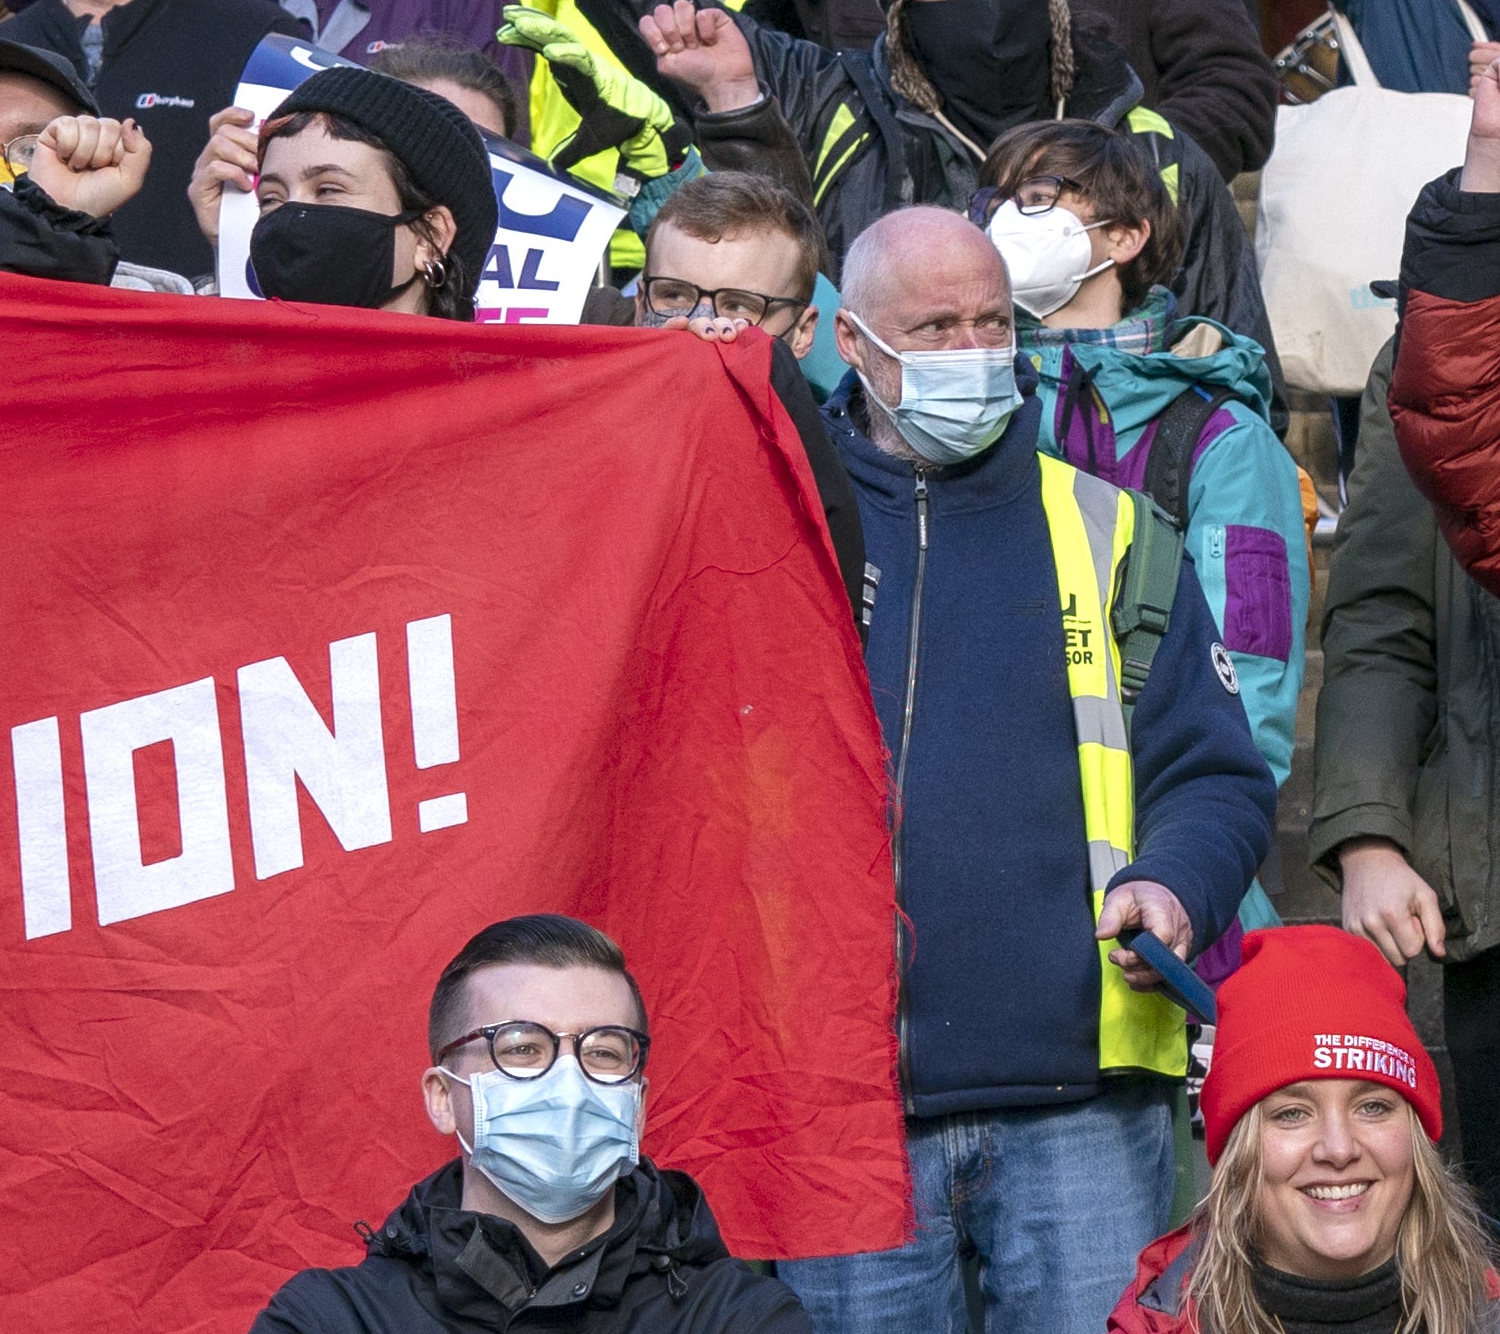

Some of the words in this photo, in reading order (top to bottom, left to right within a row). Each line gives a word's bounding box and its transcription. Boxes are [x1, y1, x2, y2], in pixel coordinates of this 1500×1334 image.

[1314, 1034, 1341, 1046] THE
[1344, 1034, 1410, 1062] DIFFERENCE
[1314, 1046, 1417, 1090] STRIKING
